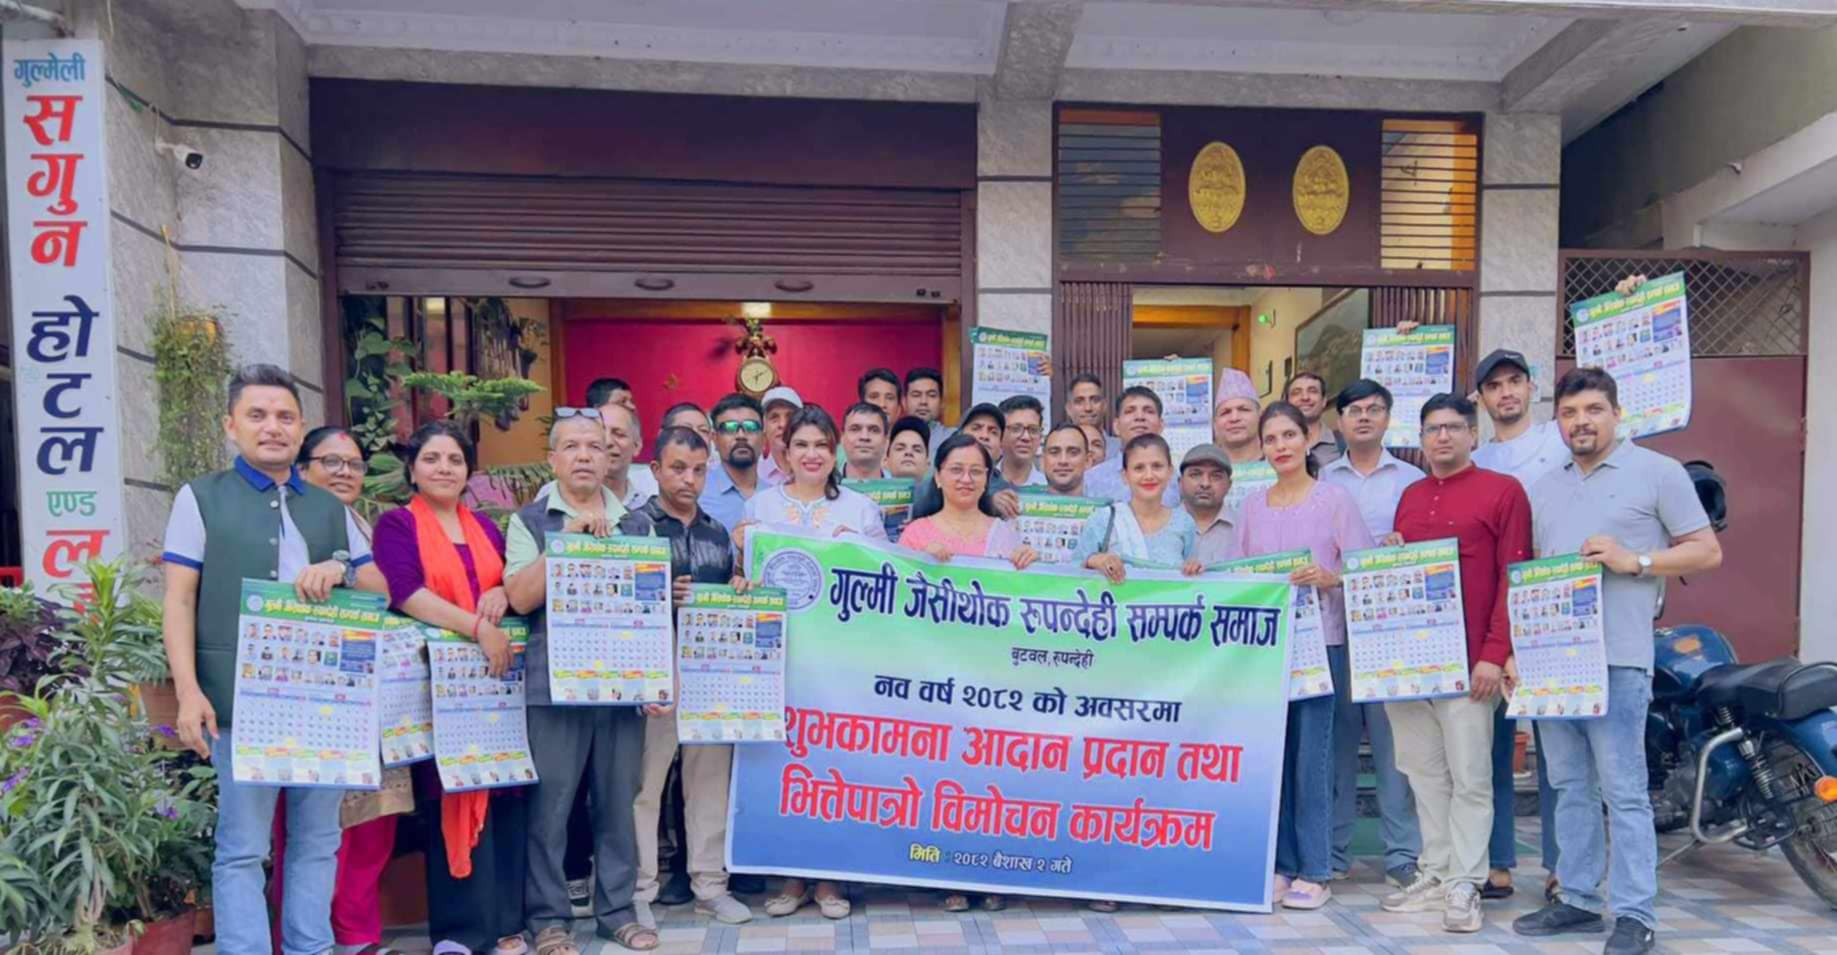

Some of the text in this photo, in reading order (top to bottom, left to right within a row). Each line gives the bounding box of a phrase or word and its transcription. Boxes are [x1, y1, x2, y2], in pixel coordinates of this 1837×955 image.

[13, 52, 86, 88] गुल्मेली
[46, 490, 98, 517] एण्ड
[829, 561, 899, 622] गुल्मी
[903, 571, 1011, 628] जैसीथोक
[1018, 589, 1118, 642] रूपन्देही
[1126, 594, 1205, 642] सम्पर्क
[1210, 605, 1281, 647] समाज
[874, 674, 1183, 723] नव वर्ष २०८२ को अवसरमा
[784, 705, 1244, 783] शुभकामना आदान प्रदान तथा
[931, 779, 1061, 840] विमोचन
[1069, 797, 1216, 850] कार्यक्रम
[909, 843, 941, 863] मिति
[954, 852, 989, 867] २०८२
[1036, 858, 1046, 871] २
[1050, 856, 1072, 873] गते
